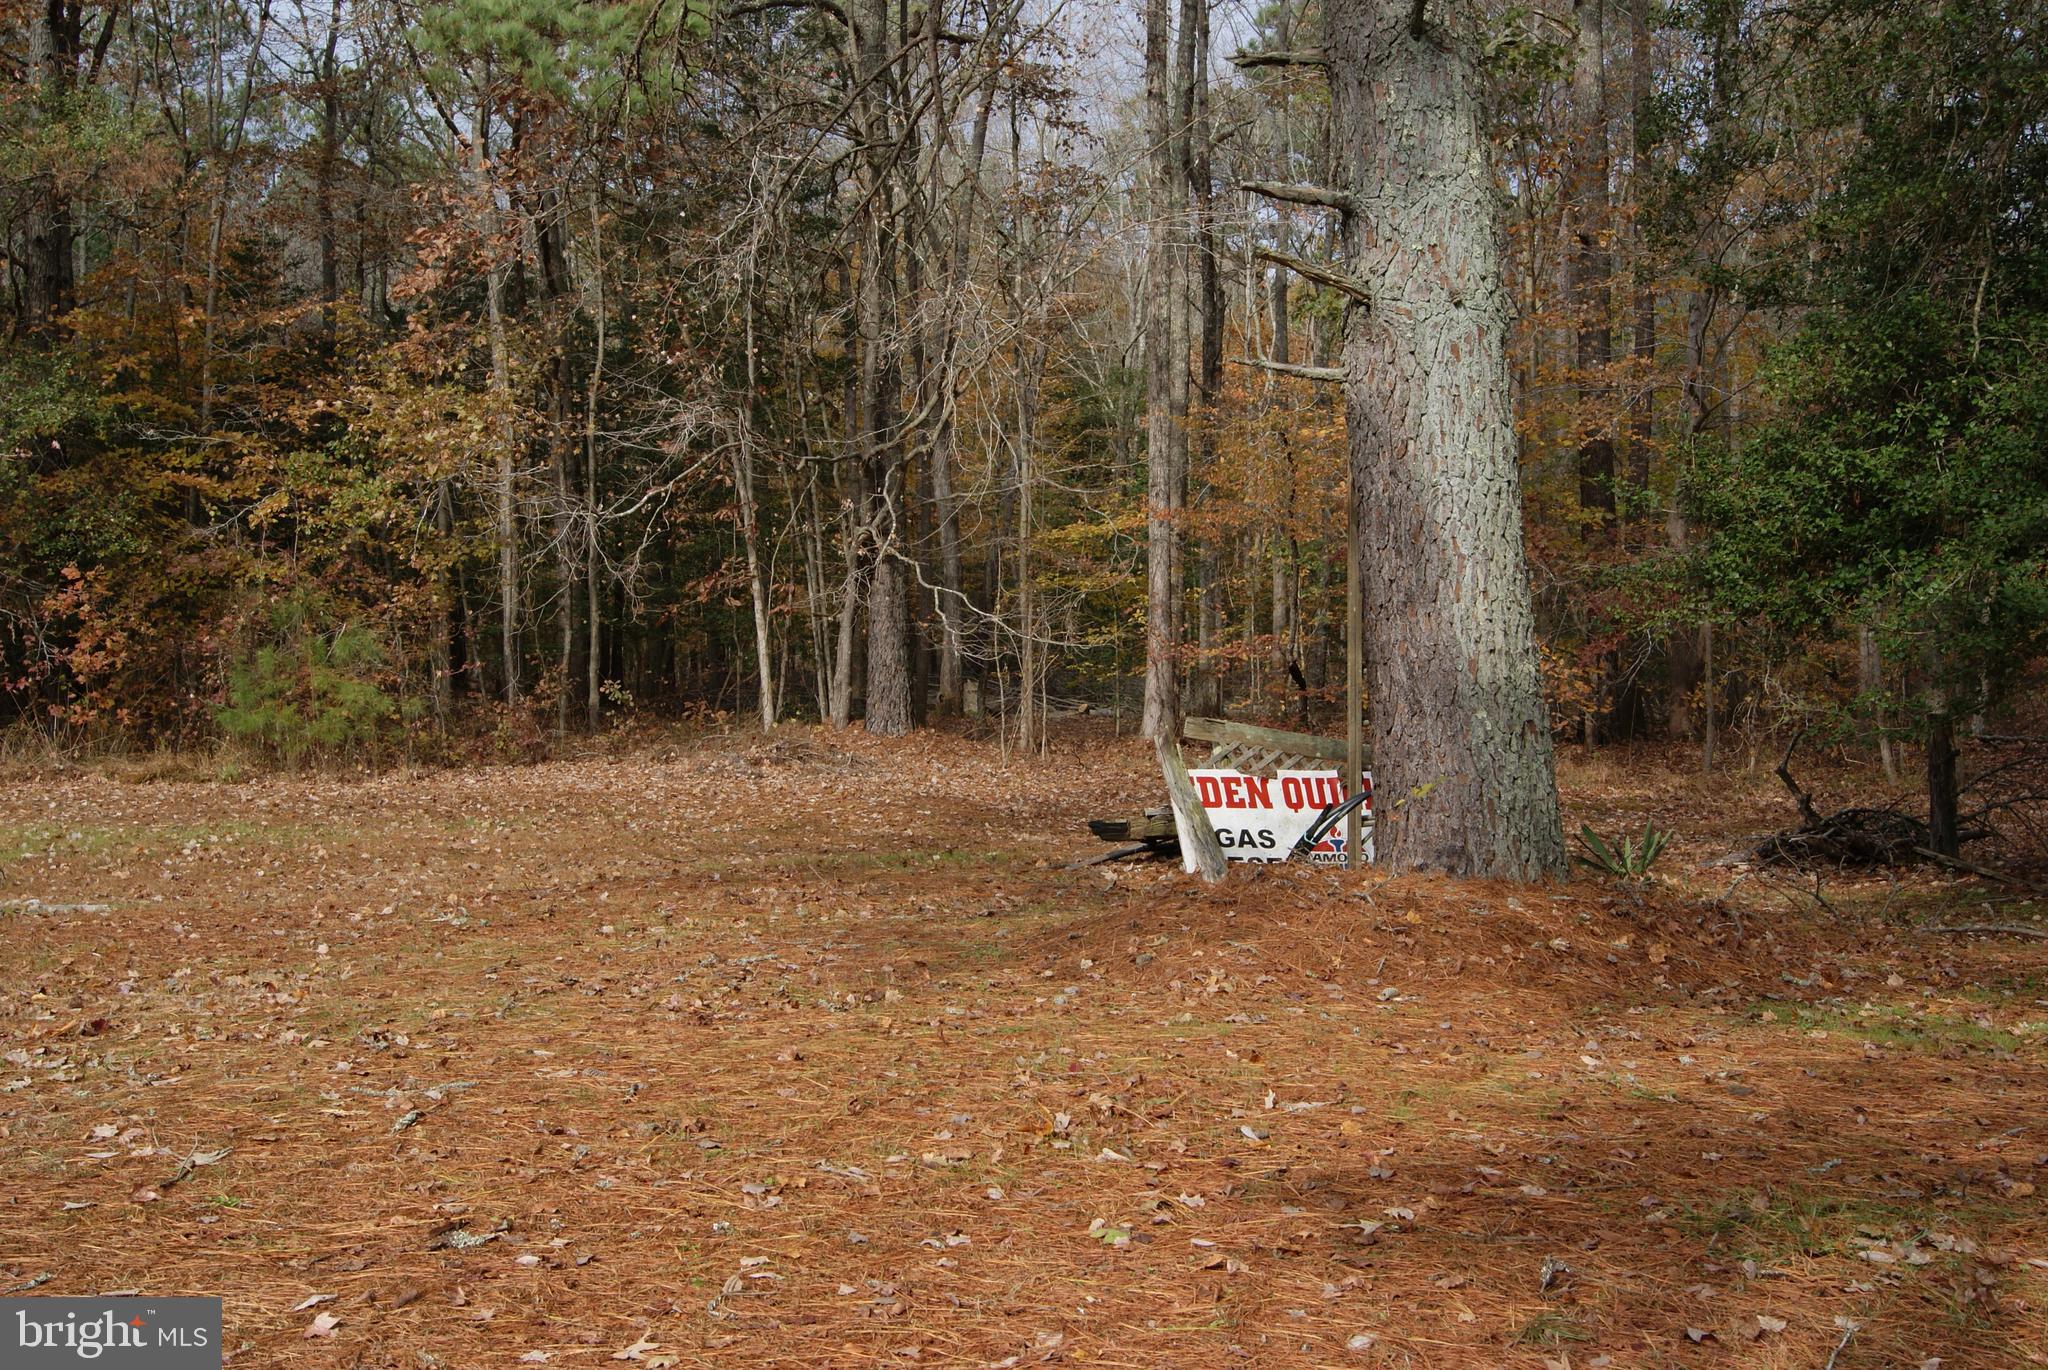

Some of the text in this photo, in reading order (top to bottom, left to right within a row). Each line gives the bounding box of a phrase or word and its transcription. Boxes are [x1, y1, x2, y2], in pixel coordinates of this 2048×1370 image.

[1189, 776, 1273, 810] DEN
[1215, 828, 1276, 849] GAS
[1313, 853, 1369, 863] AMOO
